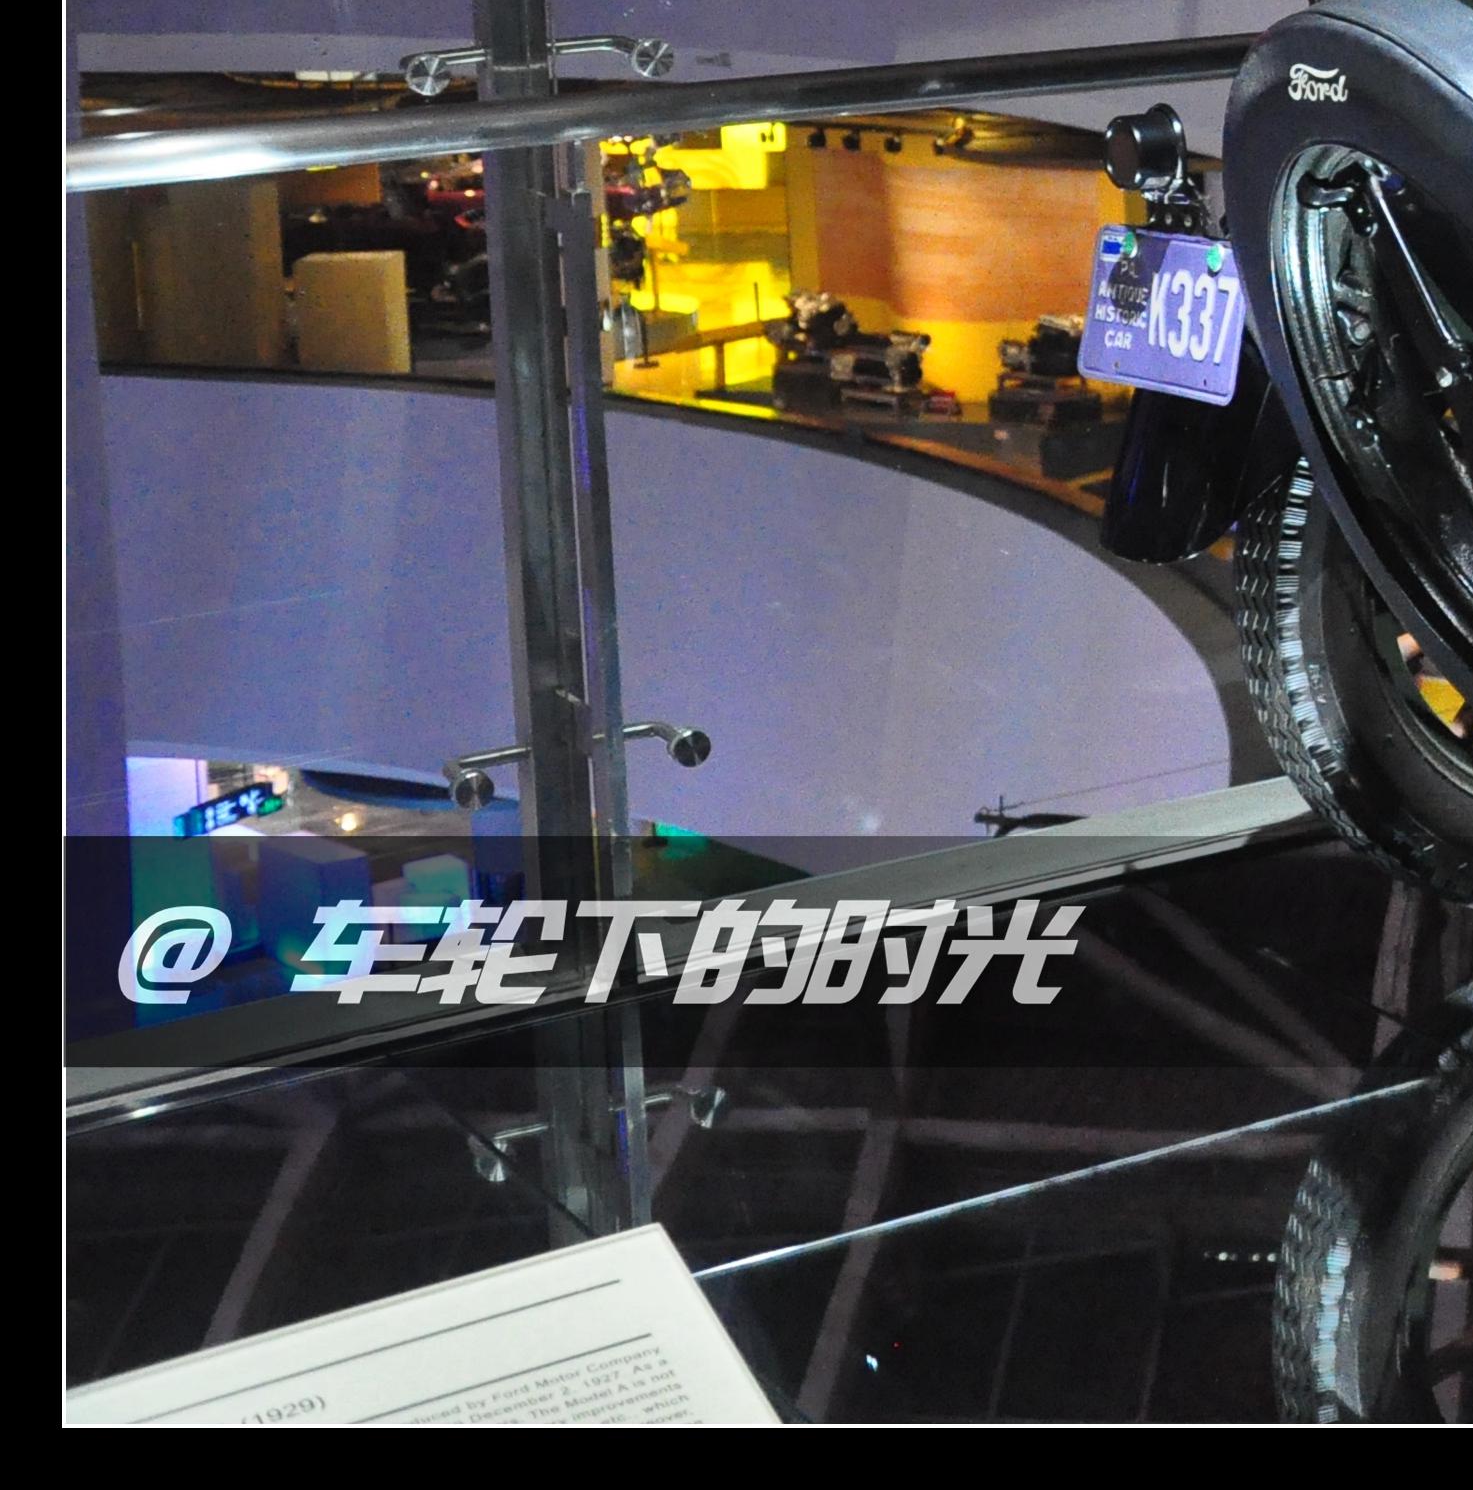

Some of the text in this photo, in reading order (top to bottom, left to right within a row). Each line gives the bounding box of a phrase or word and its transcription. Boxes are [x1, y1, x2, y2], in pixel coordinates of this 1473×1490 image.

[1288, 63, 1348, 102] Ford
[1098, 280, 1149, 306] ANTIQUE
[1095, 304, 1148, 329] HISTORIC
[1148, 269, 1240, 365] K337
[1104, 329, 1132, 350] CAR
[466, 1399, 487, 1410] by
[492, 1383, 530, 1402] Ford
[535, 1370, 581, 1390] Motor
[586, 1346, 661, 1373] Company
[469, 1392, 553, 1424] December
[632, 1363, 653, 1375] As
[658, 1358, 668, 1367] a
[529, 1369, 676, 1420] The Model A is not
[572, 1381, 683, 1422] improvements
[642, 1394, 690, 1414] which
